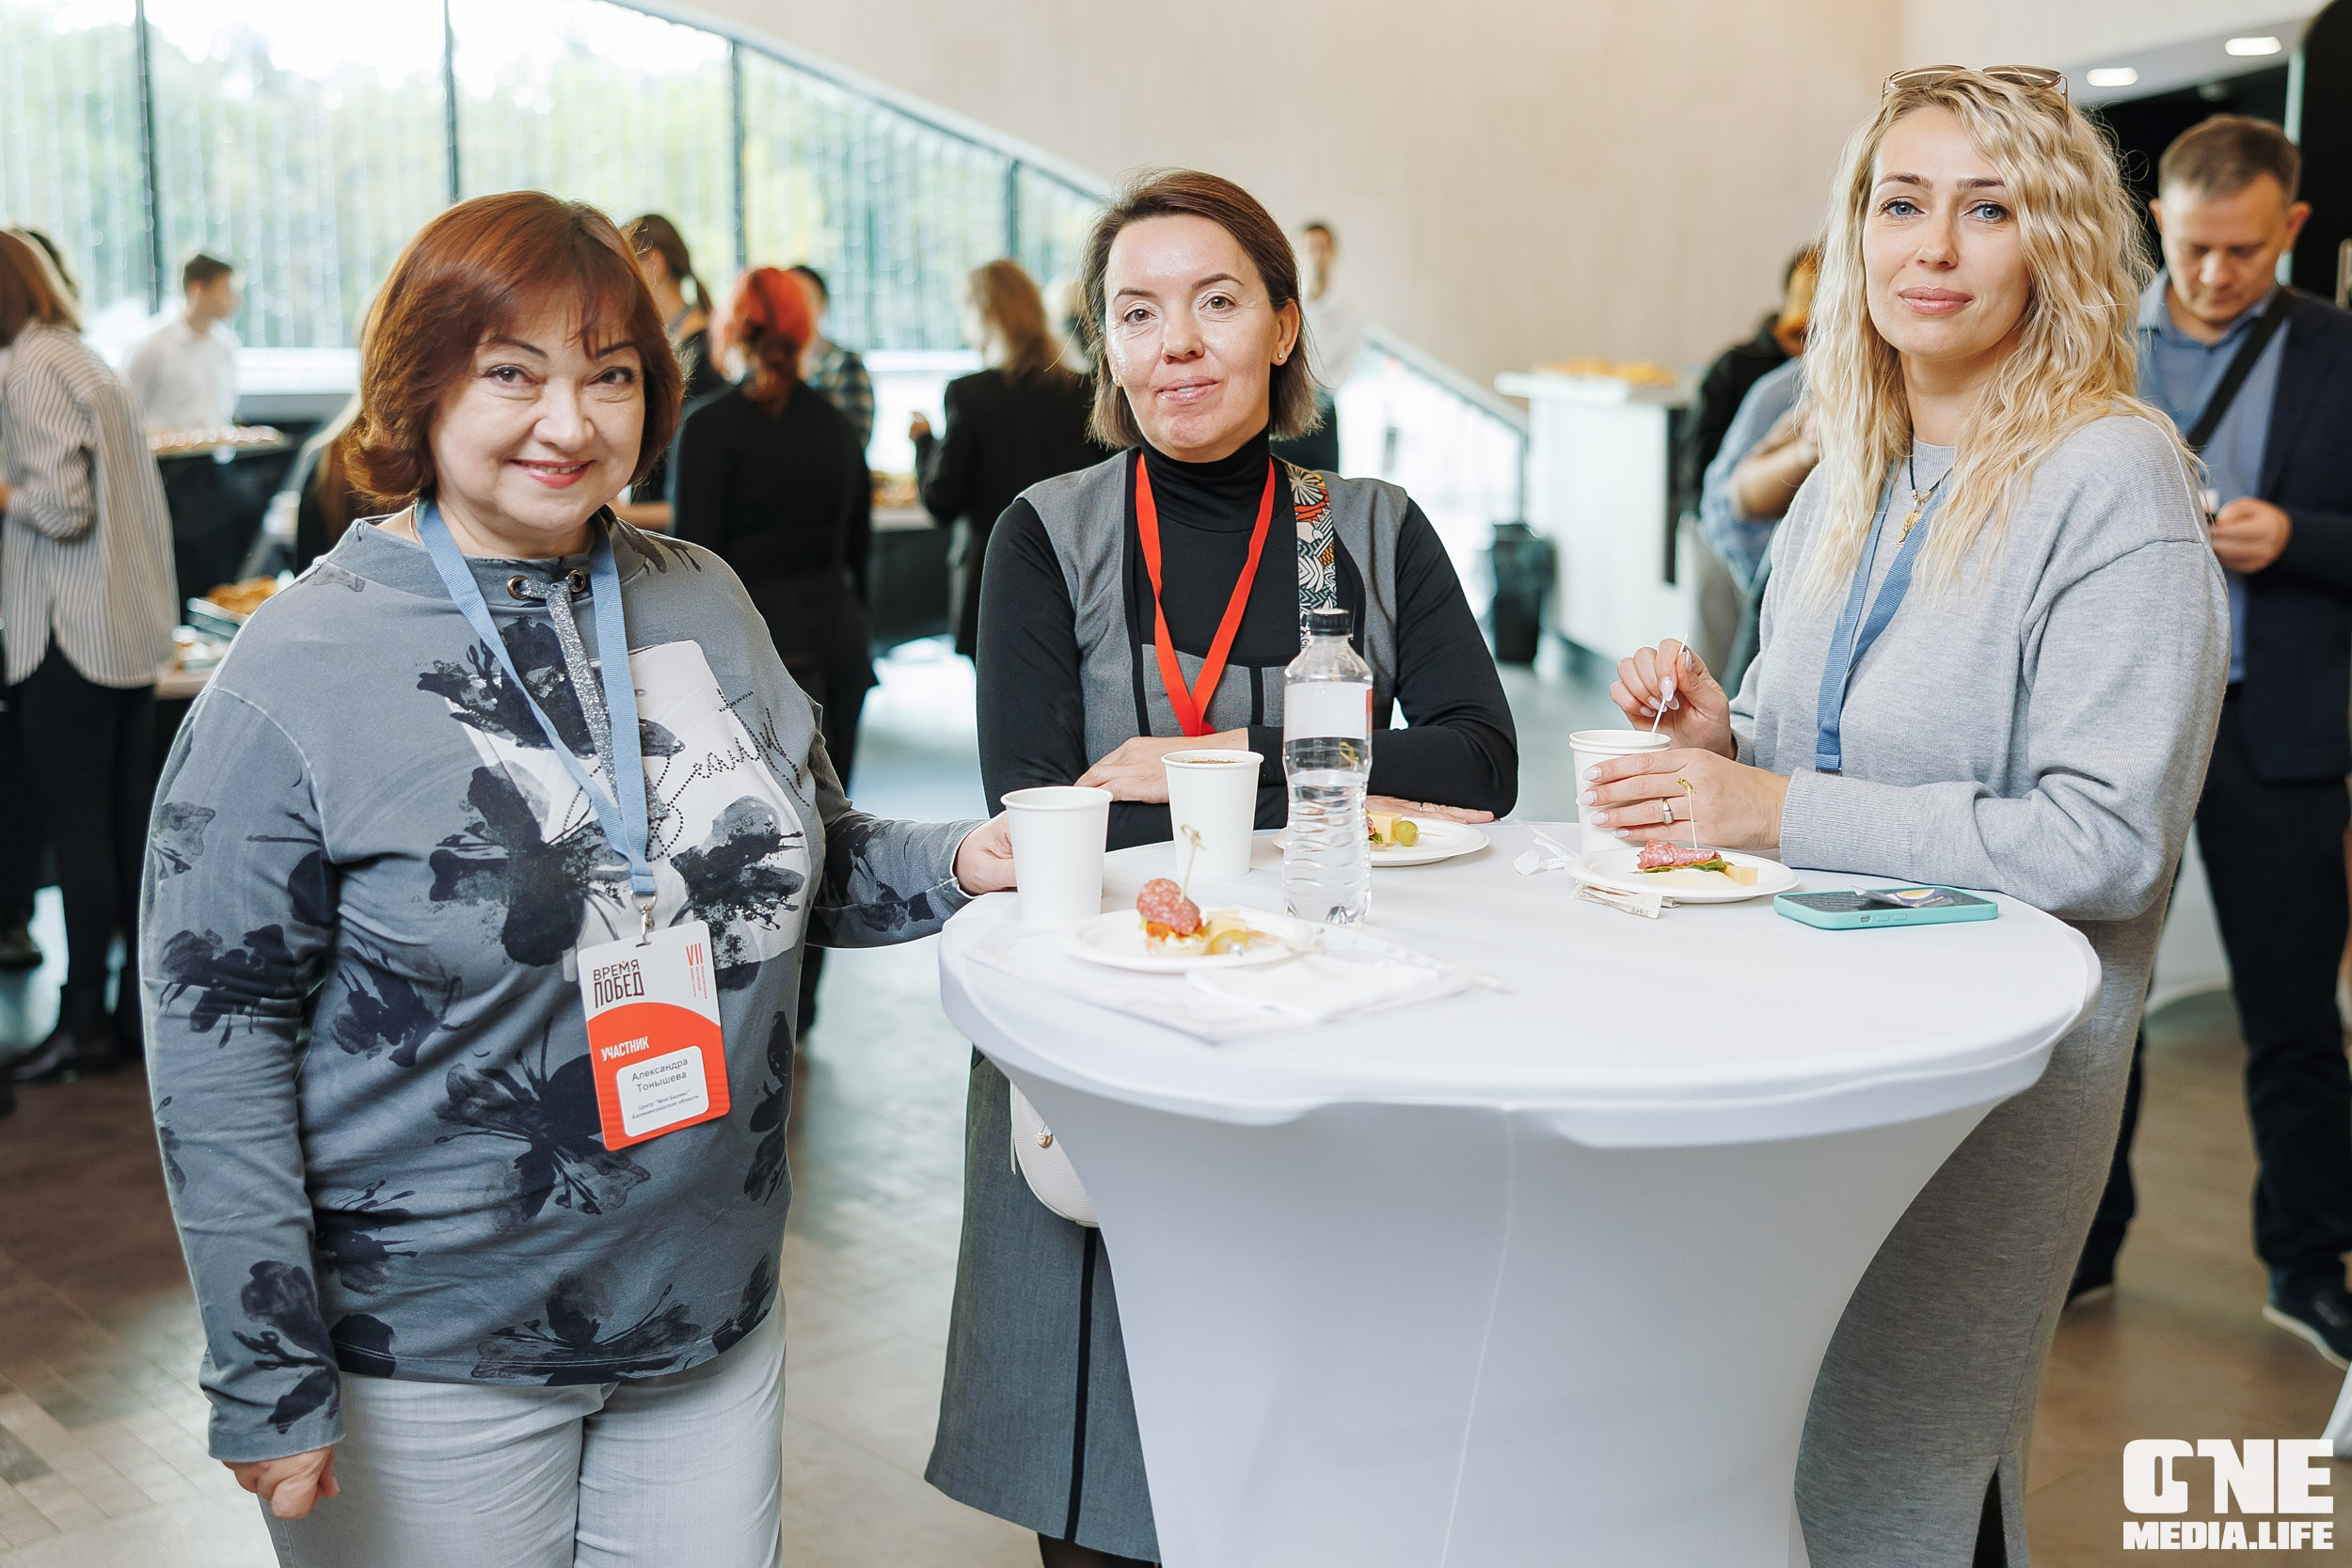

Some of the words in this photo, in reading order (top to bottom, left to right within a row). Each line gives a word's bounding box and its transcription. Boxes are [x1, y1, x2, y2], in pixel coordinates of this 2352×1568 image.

[686, 942, 704, 966] VII
[593, 959, 640, 981] ВРЕМЯ
[594, 972, 645, 1008] ПОБЕД
[601, 1036, 650, 1062] УЧАСТНИК
[631, 1058, 689, 1082] Александра
[636, 1071, 688, 1092] Тонышева
